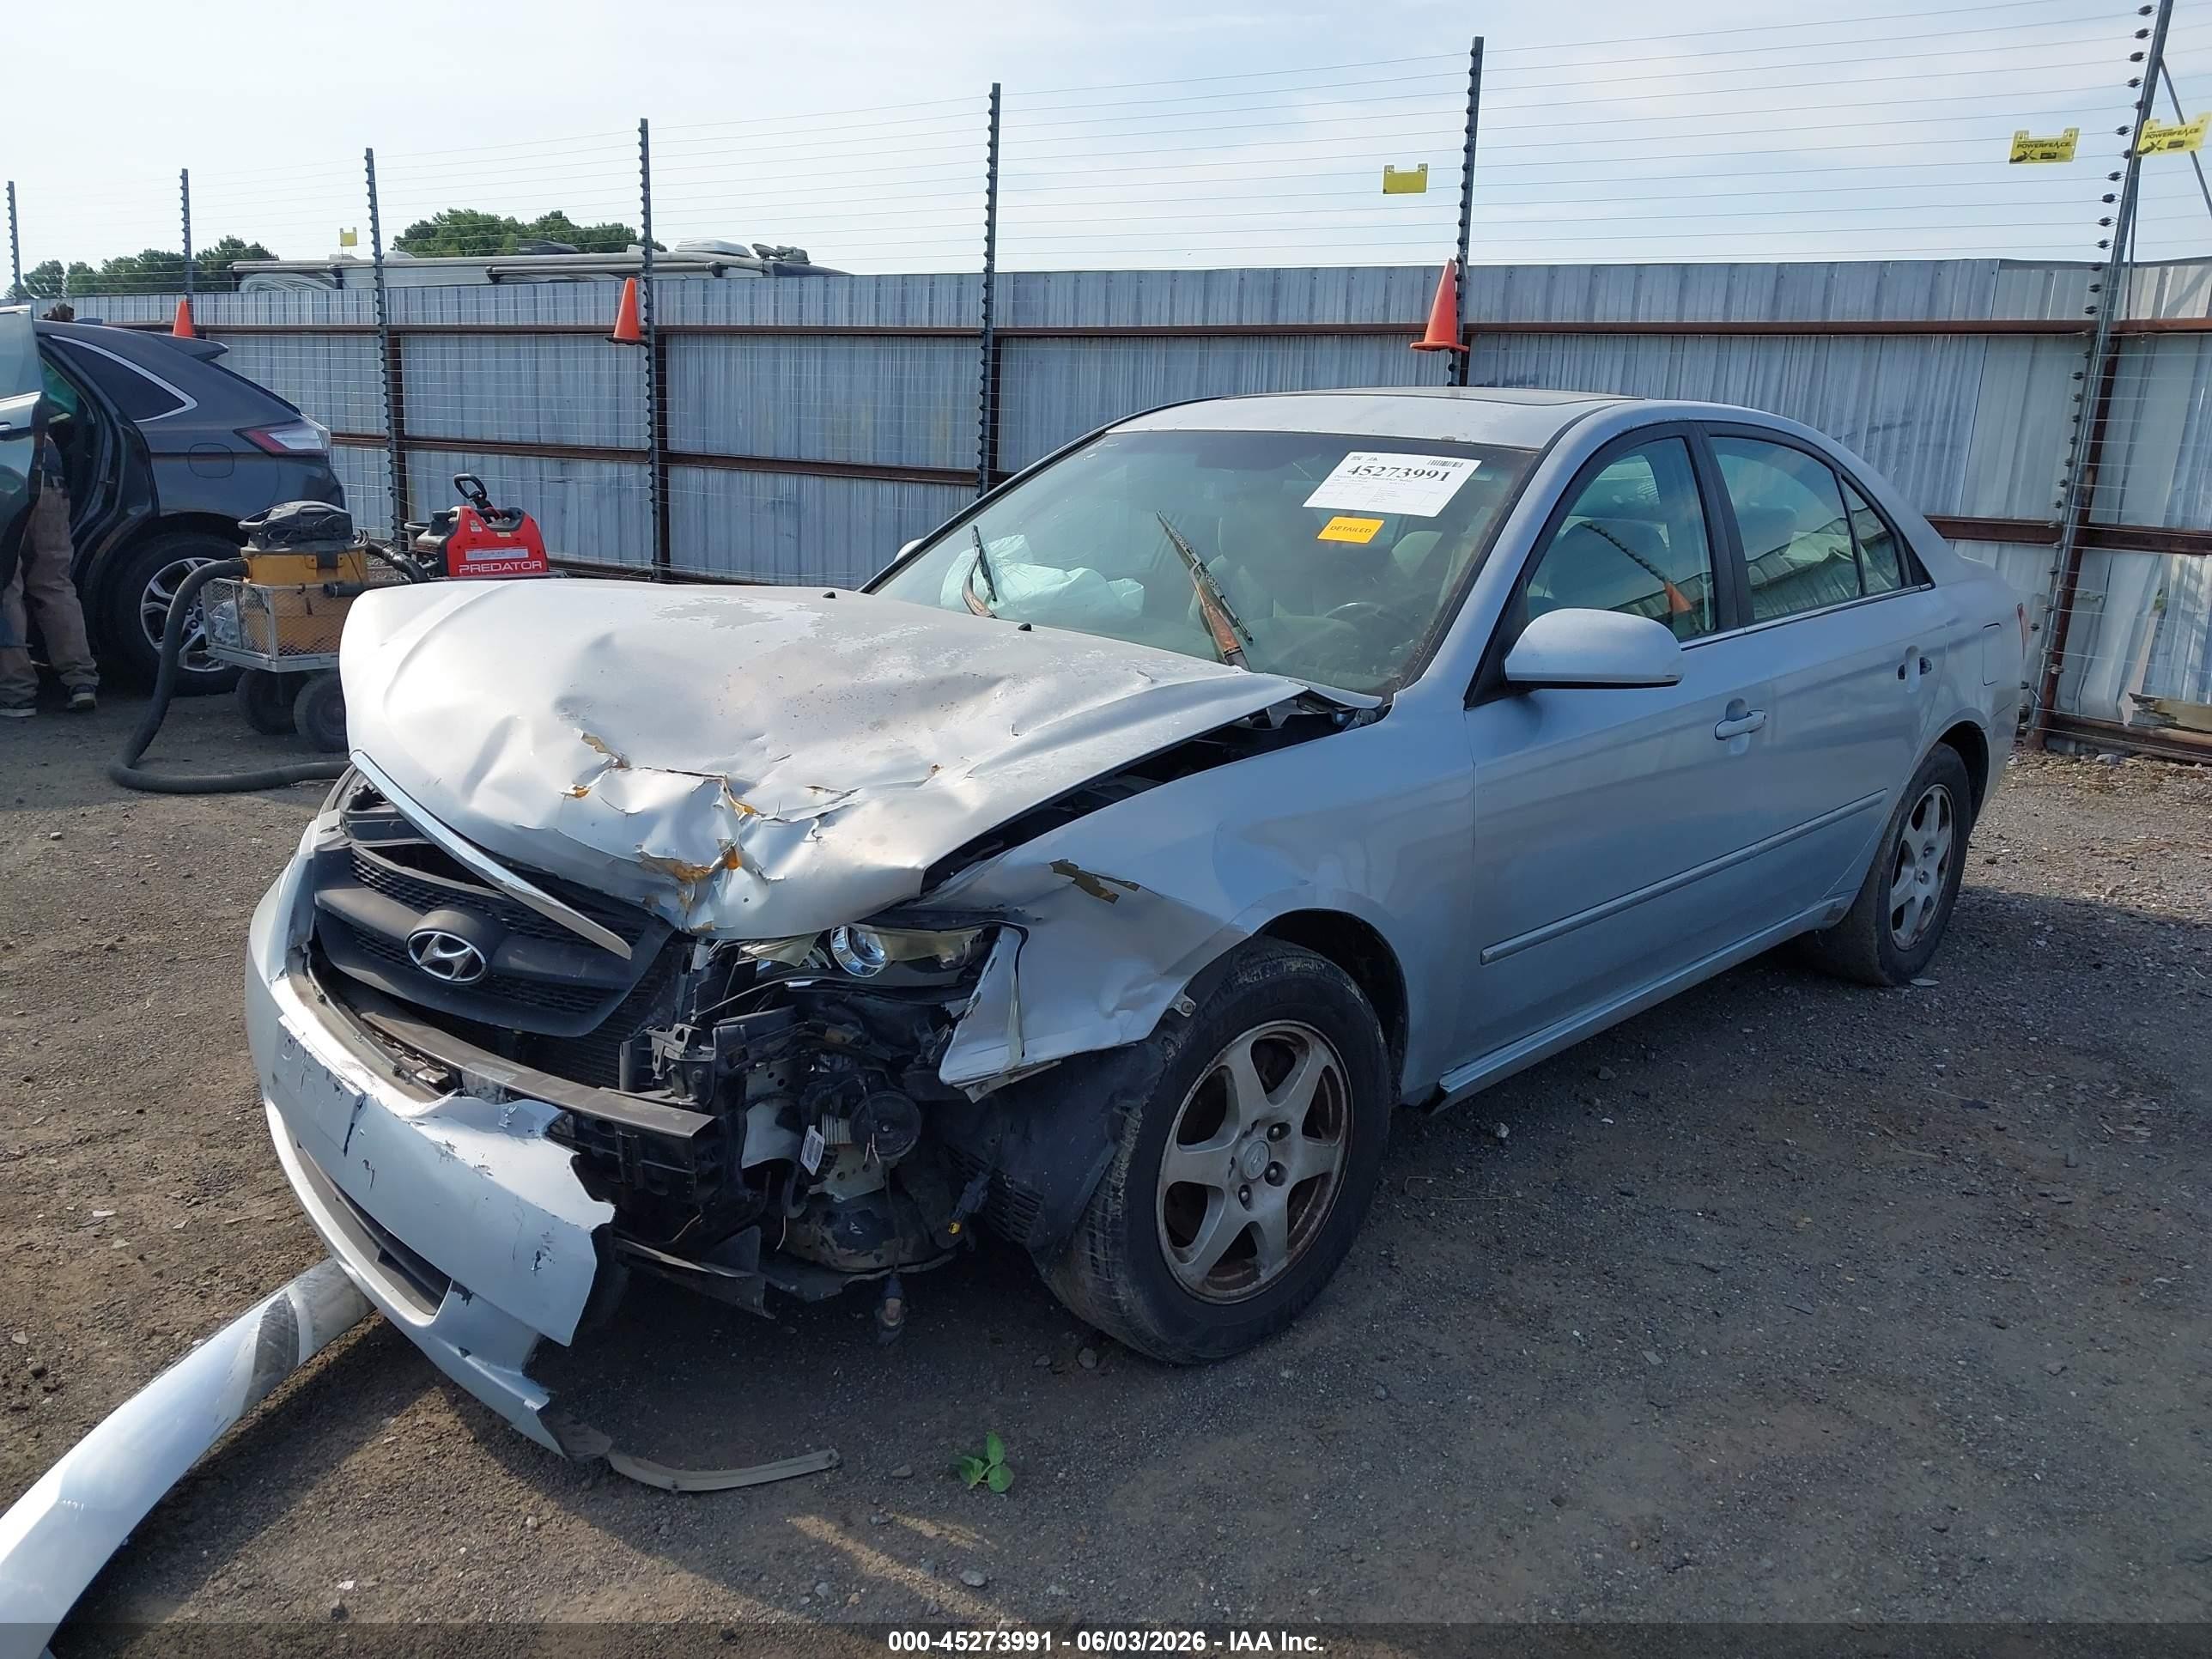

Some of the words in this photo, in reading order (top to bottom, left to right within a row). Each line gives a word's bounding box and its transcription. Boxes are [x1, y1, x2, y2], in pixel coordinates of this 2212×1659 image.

[1346, 465, 1450, 482] 45273991
[1330, 525, 1372, 533] DETAILED
[459, 560, 543, 574] PREDATOR
